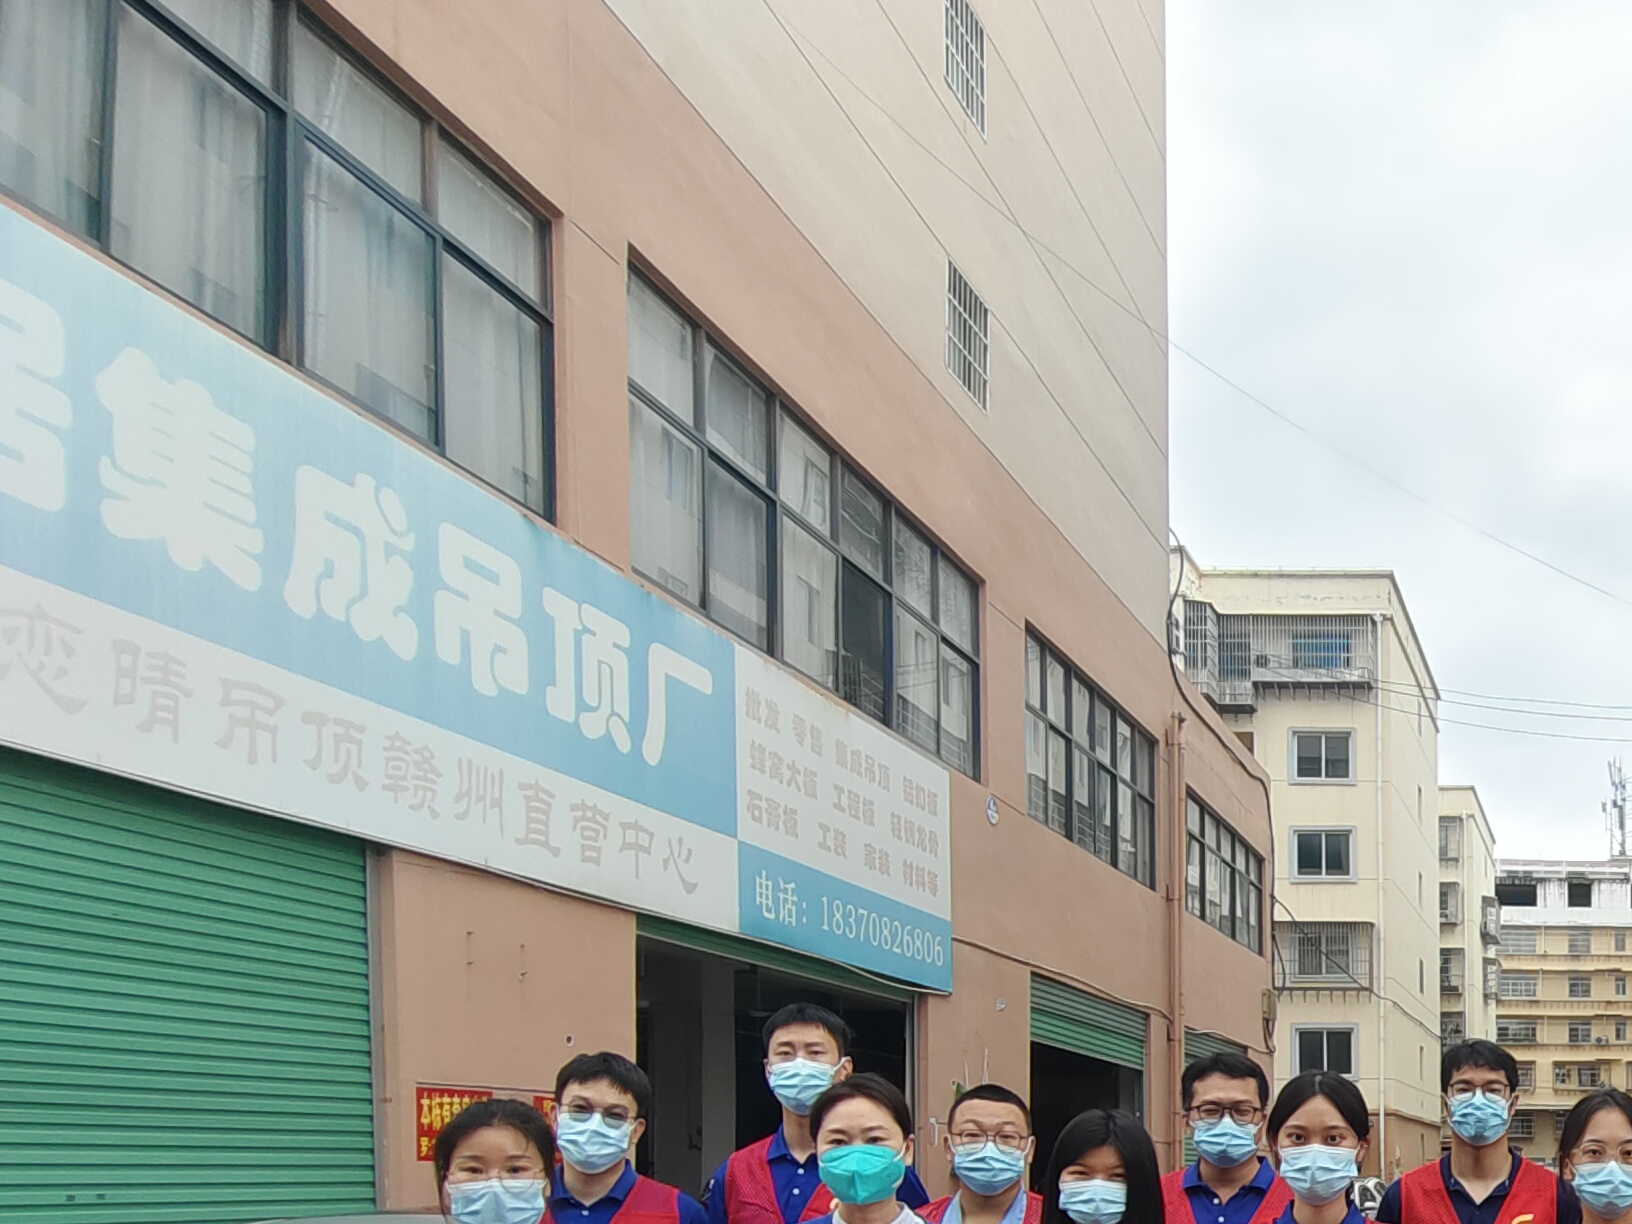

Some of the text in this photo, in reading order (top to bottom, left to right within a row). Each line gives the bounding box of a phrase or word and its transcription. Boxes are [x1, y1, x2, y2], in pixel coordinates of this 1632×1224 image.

[745, 687, 780, 735] 批发
[792, 713, 823, 757] 零售
[834, 738, 891, 793] 集成吊顶
[746, 789, 799, 840] 石膏板
[817, 821, 848, 860] 工装
